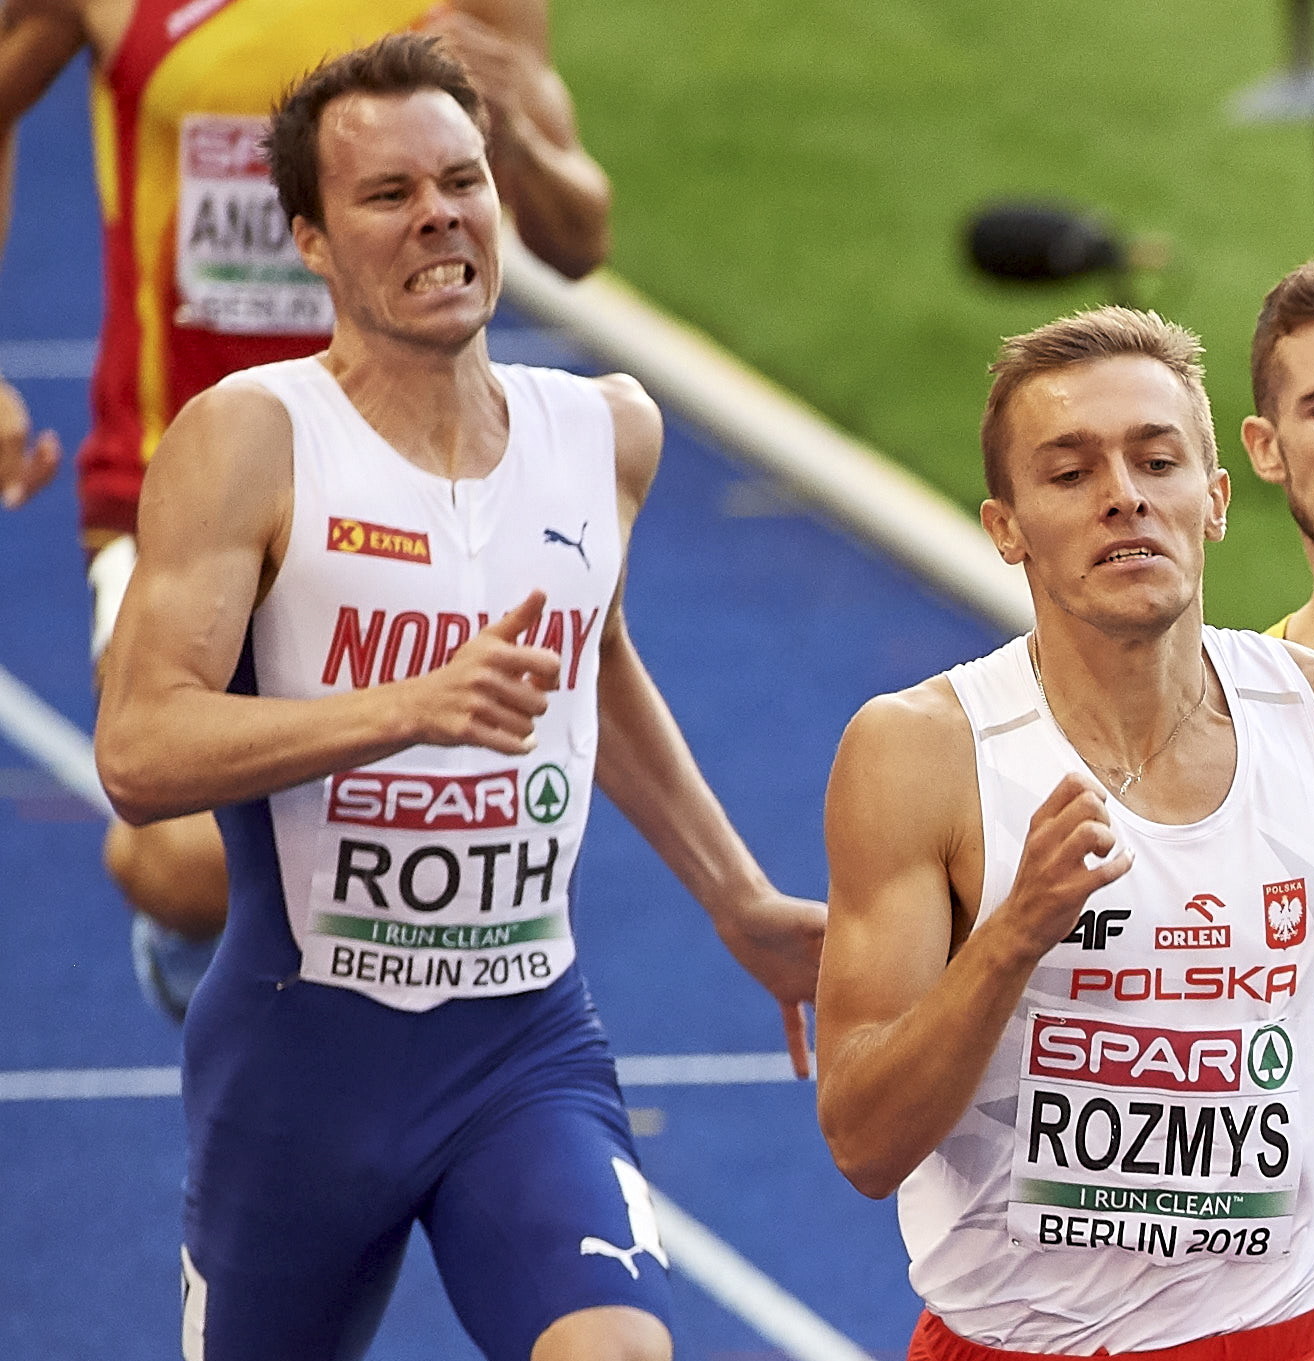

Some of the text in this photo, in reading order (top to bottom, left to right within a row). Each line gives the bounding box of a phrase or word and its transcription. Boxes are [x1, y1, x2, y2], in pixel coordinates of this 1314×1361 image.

[370, 532, 427, 556] EXTRA
[336, 777, 514, 824] SPAR
[333, 837, 560, 913] ROTH
[1266, 883, 1303, 896] POLSKA
[371, 922, 379, 941] I
[386, 922, 435, 946] RUN
[1157, 929, 1226, 947] ORLEN
[331, 947, 551, 987] BERLIN 2018
[1069, 963, 1298, 1005] POLSKA
[1036, 1026, 1238, 1084] SPAR
[1027, 1090, 1290, 1179] ROZMYS
[1080, 1188, 1086, 1207] I
[1095, 1189, 1147, 1210] RUN
[1039, 1214, 1271, 1258] BERLIN 2018
